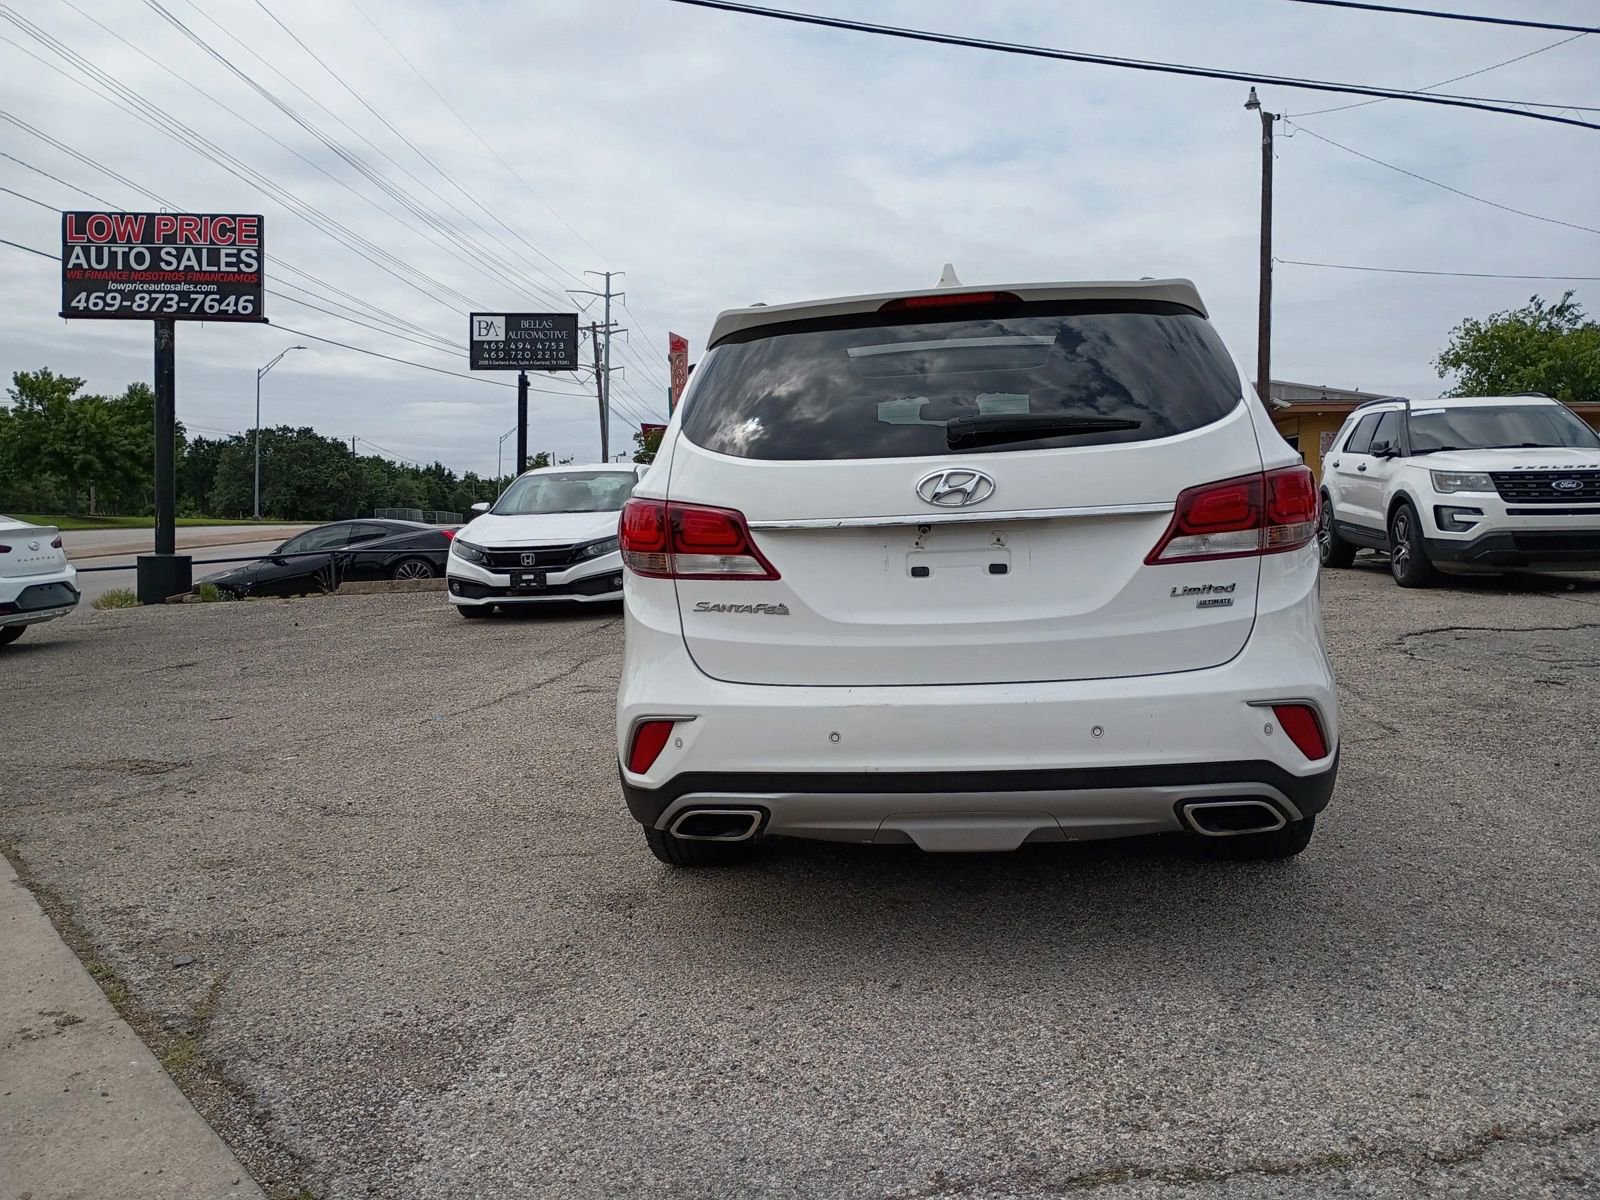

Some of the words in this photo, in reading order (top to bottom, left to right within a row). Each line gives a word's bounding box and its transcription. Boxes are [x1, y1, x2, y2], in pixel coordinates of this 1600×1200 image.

[66, 214, 146, 243] LOW
[154, 215, 259, 245] PRICE
[67, 246, 151, 271] AUTO
[159, 247, 259, 272] SALES
[66, 270, 84, 280] WE
[84, 271, 128, 280] FINANCE
[130, 271, 185, 281] NOSOTROS
[187, 272, 258, 283] FINANCIAMOS
[107, 281, 218, 292] lowpriceautosales.com
[70, 292, 254, 314] 469-873-7646
[520, 320, 553, 328] BELLAS
[507, 330, 569, 339] AUTOMOTIVE
[1170, 582, 1237, 598] Limited
[1199, 598, 1232, 606] ULTIMATE
